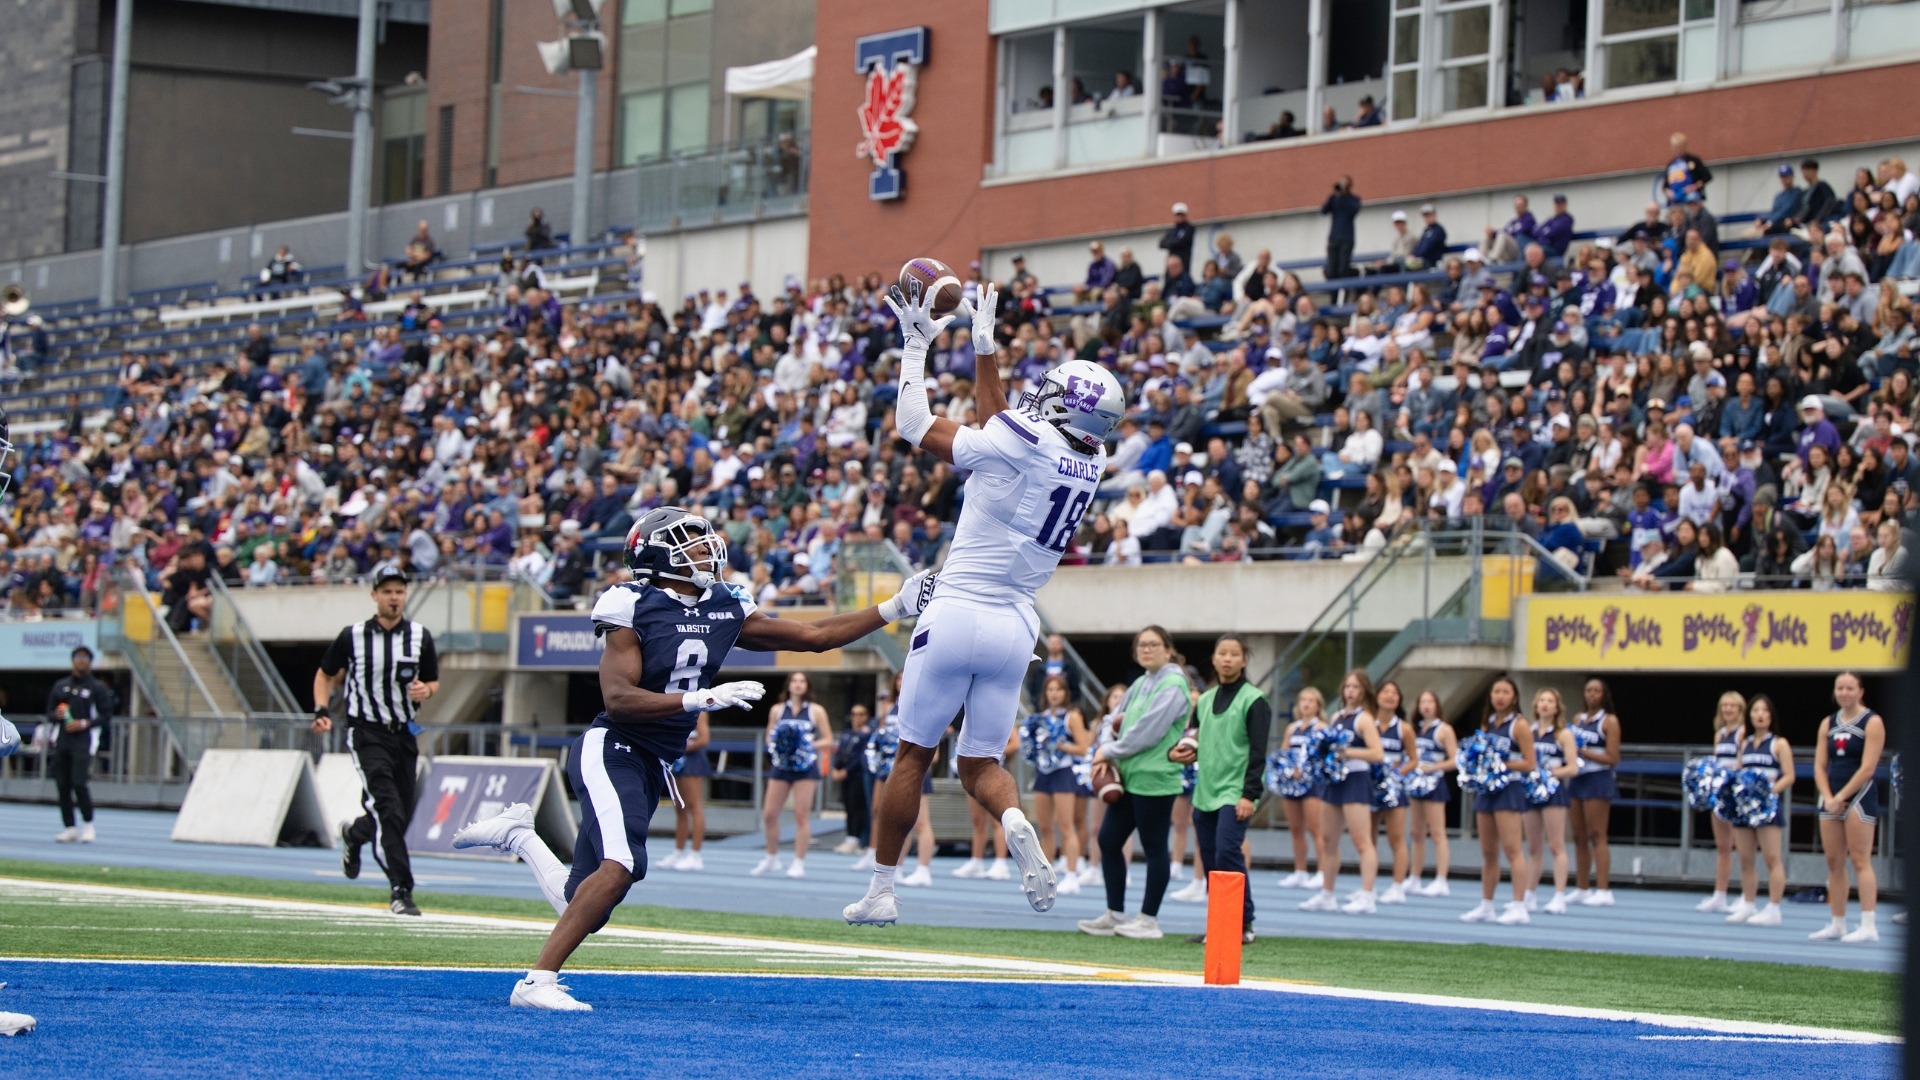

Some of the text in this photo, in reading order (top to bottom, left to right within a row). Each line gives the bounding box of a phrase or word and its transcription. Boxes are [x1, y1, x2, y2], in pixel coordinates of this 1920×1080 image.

[1058, 456, 1099, 483] CHARLES
[1036, 485, 1091, 552] 18
[920, 575, 935, 608] TTLE
[675, 624, 711, 634] VARSITY
[1546, 612, 1662, 652] Booster Juice
[1683, 610, 1808, 652] Booster Juice
[1830, 611, 1891, 651] Booster
[664, 639, 708, 694] 8
